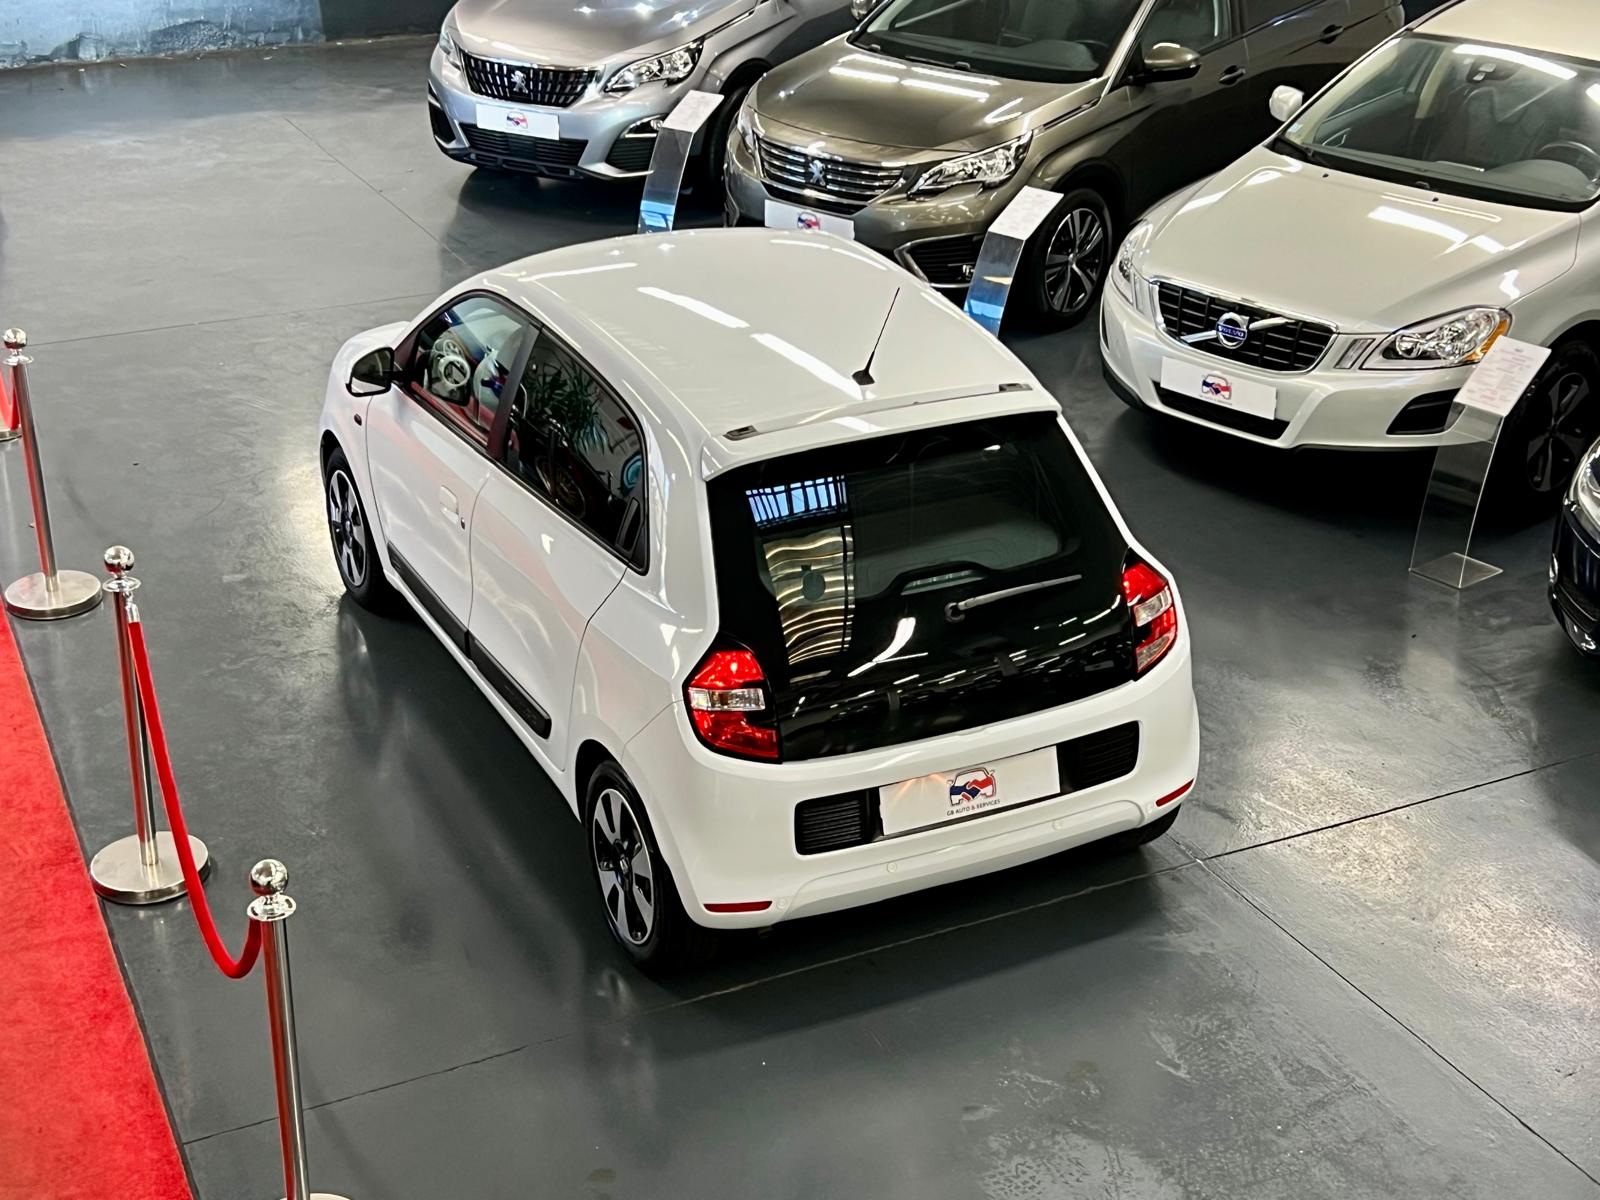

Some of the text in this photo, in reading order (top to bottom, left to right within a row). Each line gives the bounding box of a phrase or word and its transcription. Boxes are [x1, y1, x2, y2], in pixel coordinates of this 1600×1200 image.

[1218, 325, 1244, 337] VOLVO
[955, 806, 970, 814] AUTO
[976, 799, 1001, 809] SERVICES
